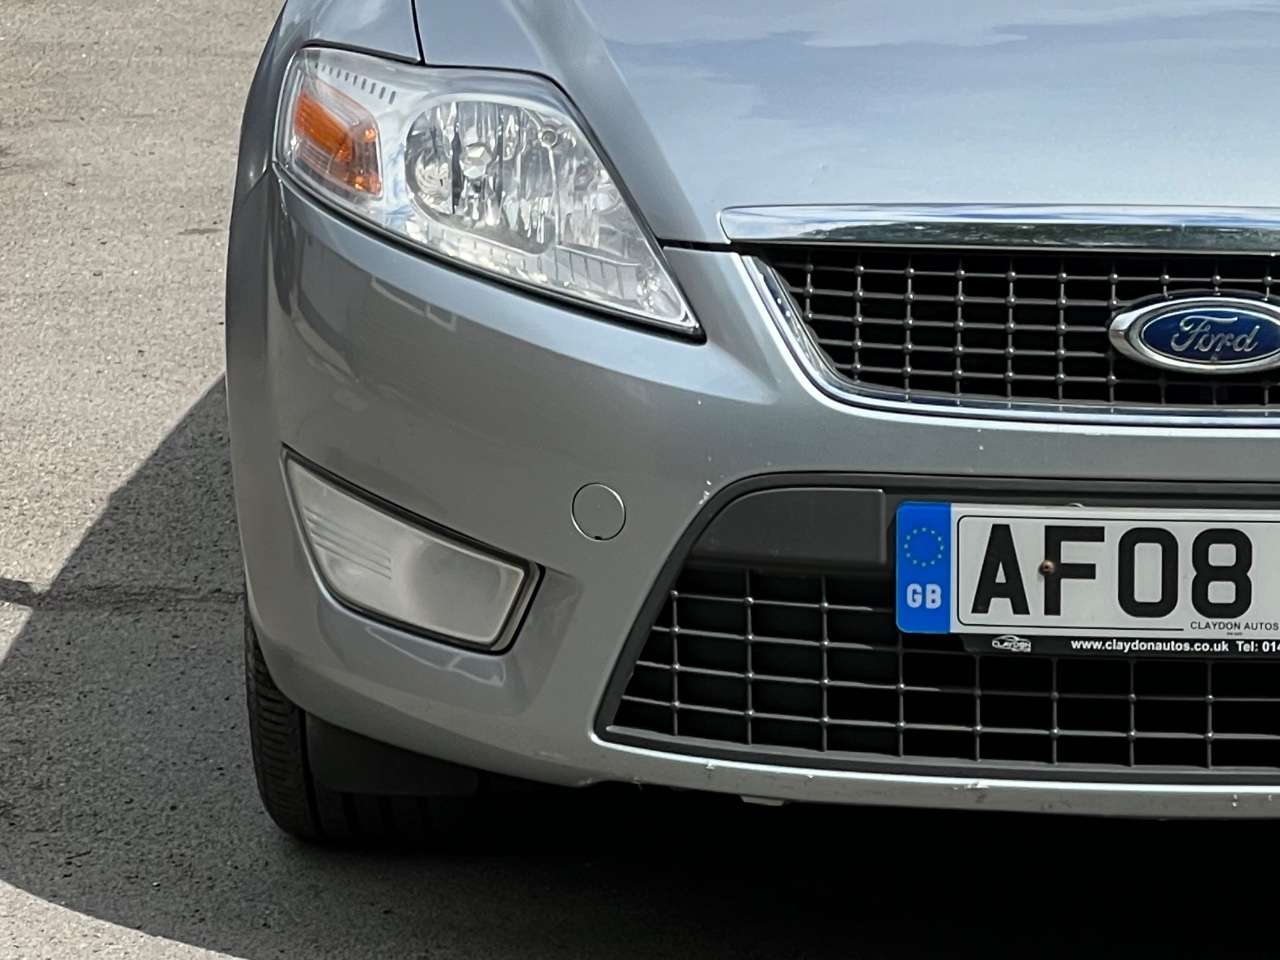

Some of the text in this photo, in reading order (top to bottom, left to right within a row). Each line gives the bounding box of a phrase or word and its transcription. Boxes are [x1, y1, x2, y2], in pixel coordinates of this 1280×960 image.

[1170, 315, 1260, 353] Ford
[971, 523, 1253, 619] AF08
[906, 583, 942, 609] GB
[1190, 621, 1279, 631] CLAYDON AUTOS
[1070, 639, 1229, 653] www.claydonautos.co.uk
[1236, 640, 1258, 653] Tel:
